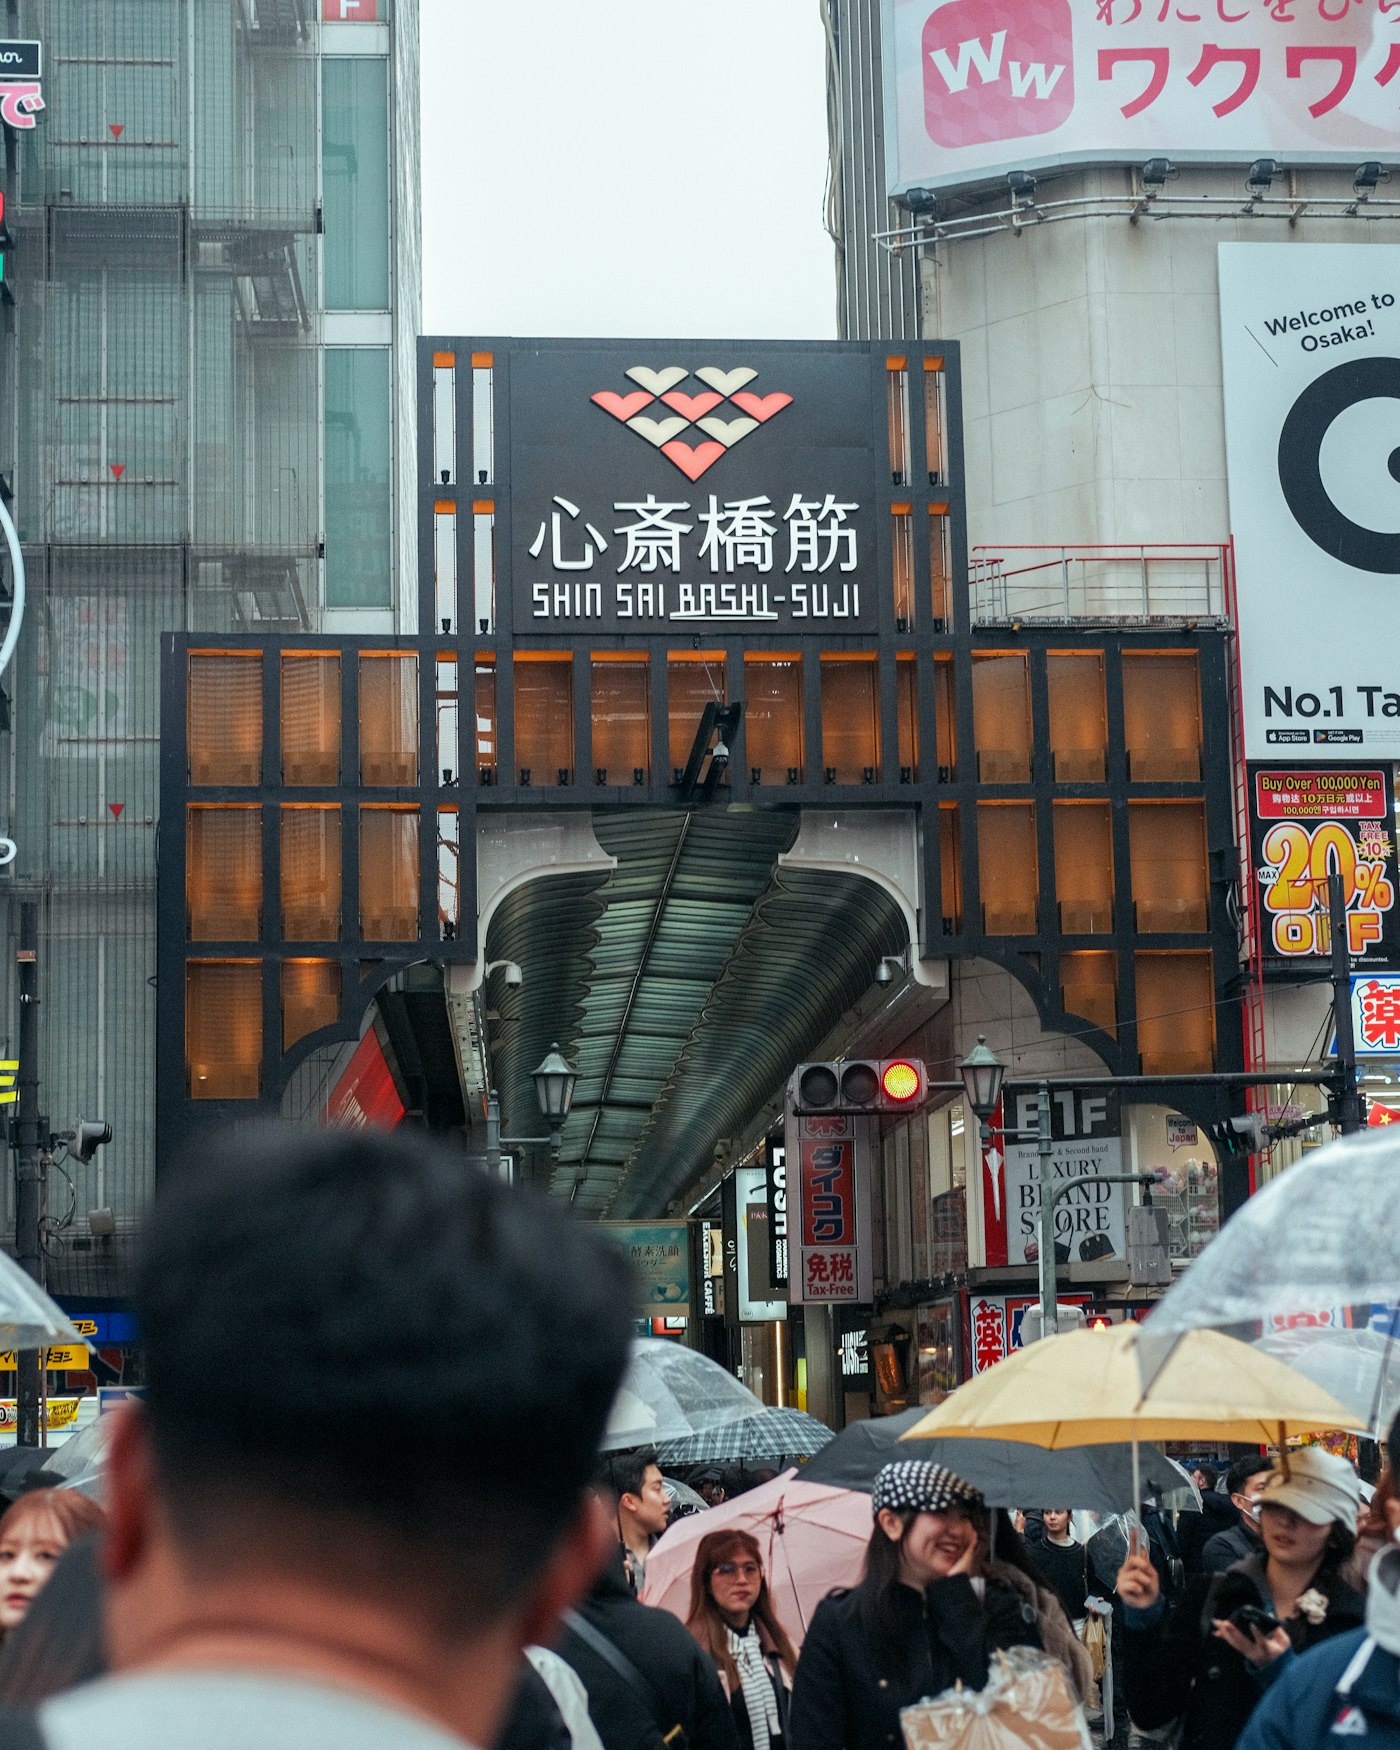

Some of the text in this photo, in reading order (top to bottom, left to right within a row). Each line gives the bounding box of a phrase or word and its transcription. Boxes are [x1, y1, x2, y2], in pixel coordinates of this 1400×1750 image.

[1264, 293, 1395, 336] Welcome to
[1301, 319, 1375, 352] Osaka!
[528, 493, 860, 574] 心斎橋筋
[532, 583, 602, 617] SHIN
[616, 583, 664, 617] SAI
[1264, 686, 1344, 717] No.1
[1262, 777, 1380, 791] Buy Over 100,000 Yen
[1322, 806, 1359, 814] 구입하시면
[1359, 821, 1381, 831] TAX
[1360, 831, 1388, 840] FREE
[1258, 870, 1278, 880] MAX
[1262, 821, 1394, 913] 20%
[1065, 1147, 1090, 1155] Second
[1092, 1145, 1108, 1153] hand
[1169, 1133, 1196, 1143] Japan
[1028, 1159, 1102, 1180] LXURY
[811, 1145, 844, 1243] ダイコク
[1018, 1181, 1112, 1208] BAND
[1020, 1206, 1111, 1235] SORE
[776, 1239, 784, 1279] COSMETICS
[806, 1252, 854, 1283] 免税
[704, 1280, 715, 1315] CAFFÉ
[807, 1283, 854, 1295] Tax-Free
[975, 1300, 1003, 1372] 薬
